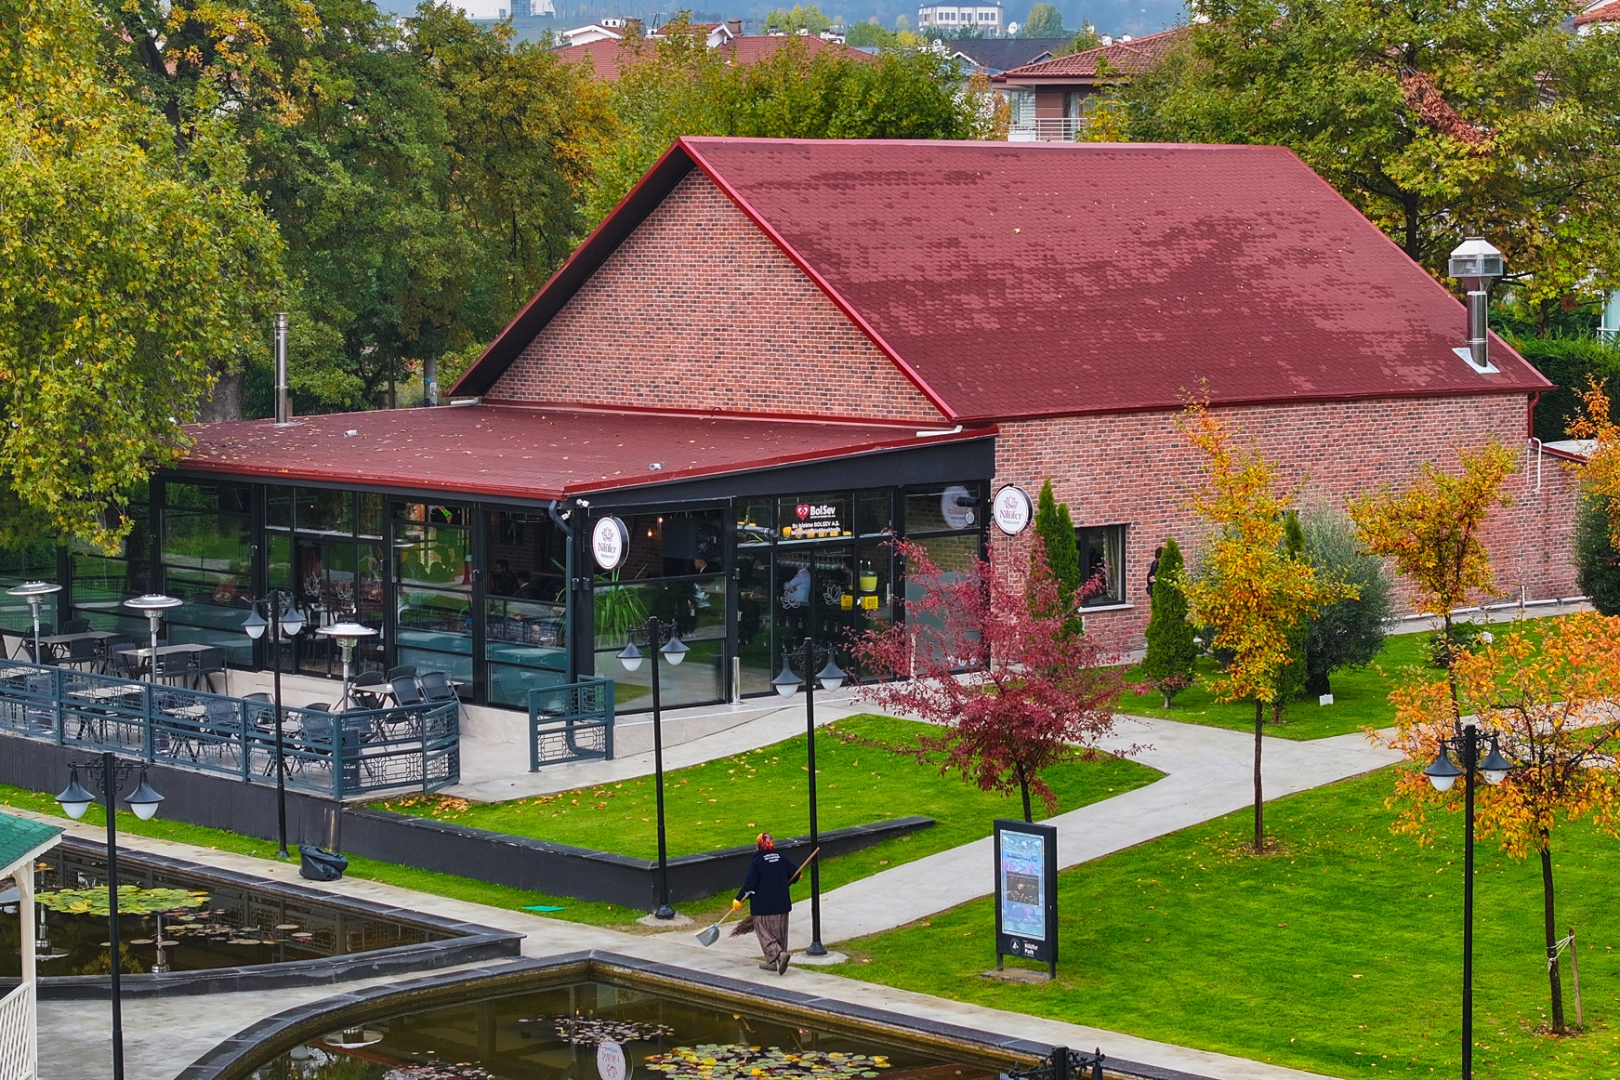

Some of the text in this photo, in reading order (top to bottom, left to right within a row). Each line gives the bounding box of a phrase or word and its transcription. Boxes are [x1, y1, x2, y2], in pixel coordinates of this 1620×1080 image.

[810, 505, 836, 516] BolSev
[999, 509, 1023, 520] Nilüfer
[598, 542, 617, 554] Nilüfer
